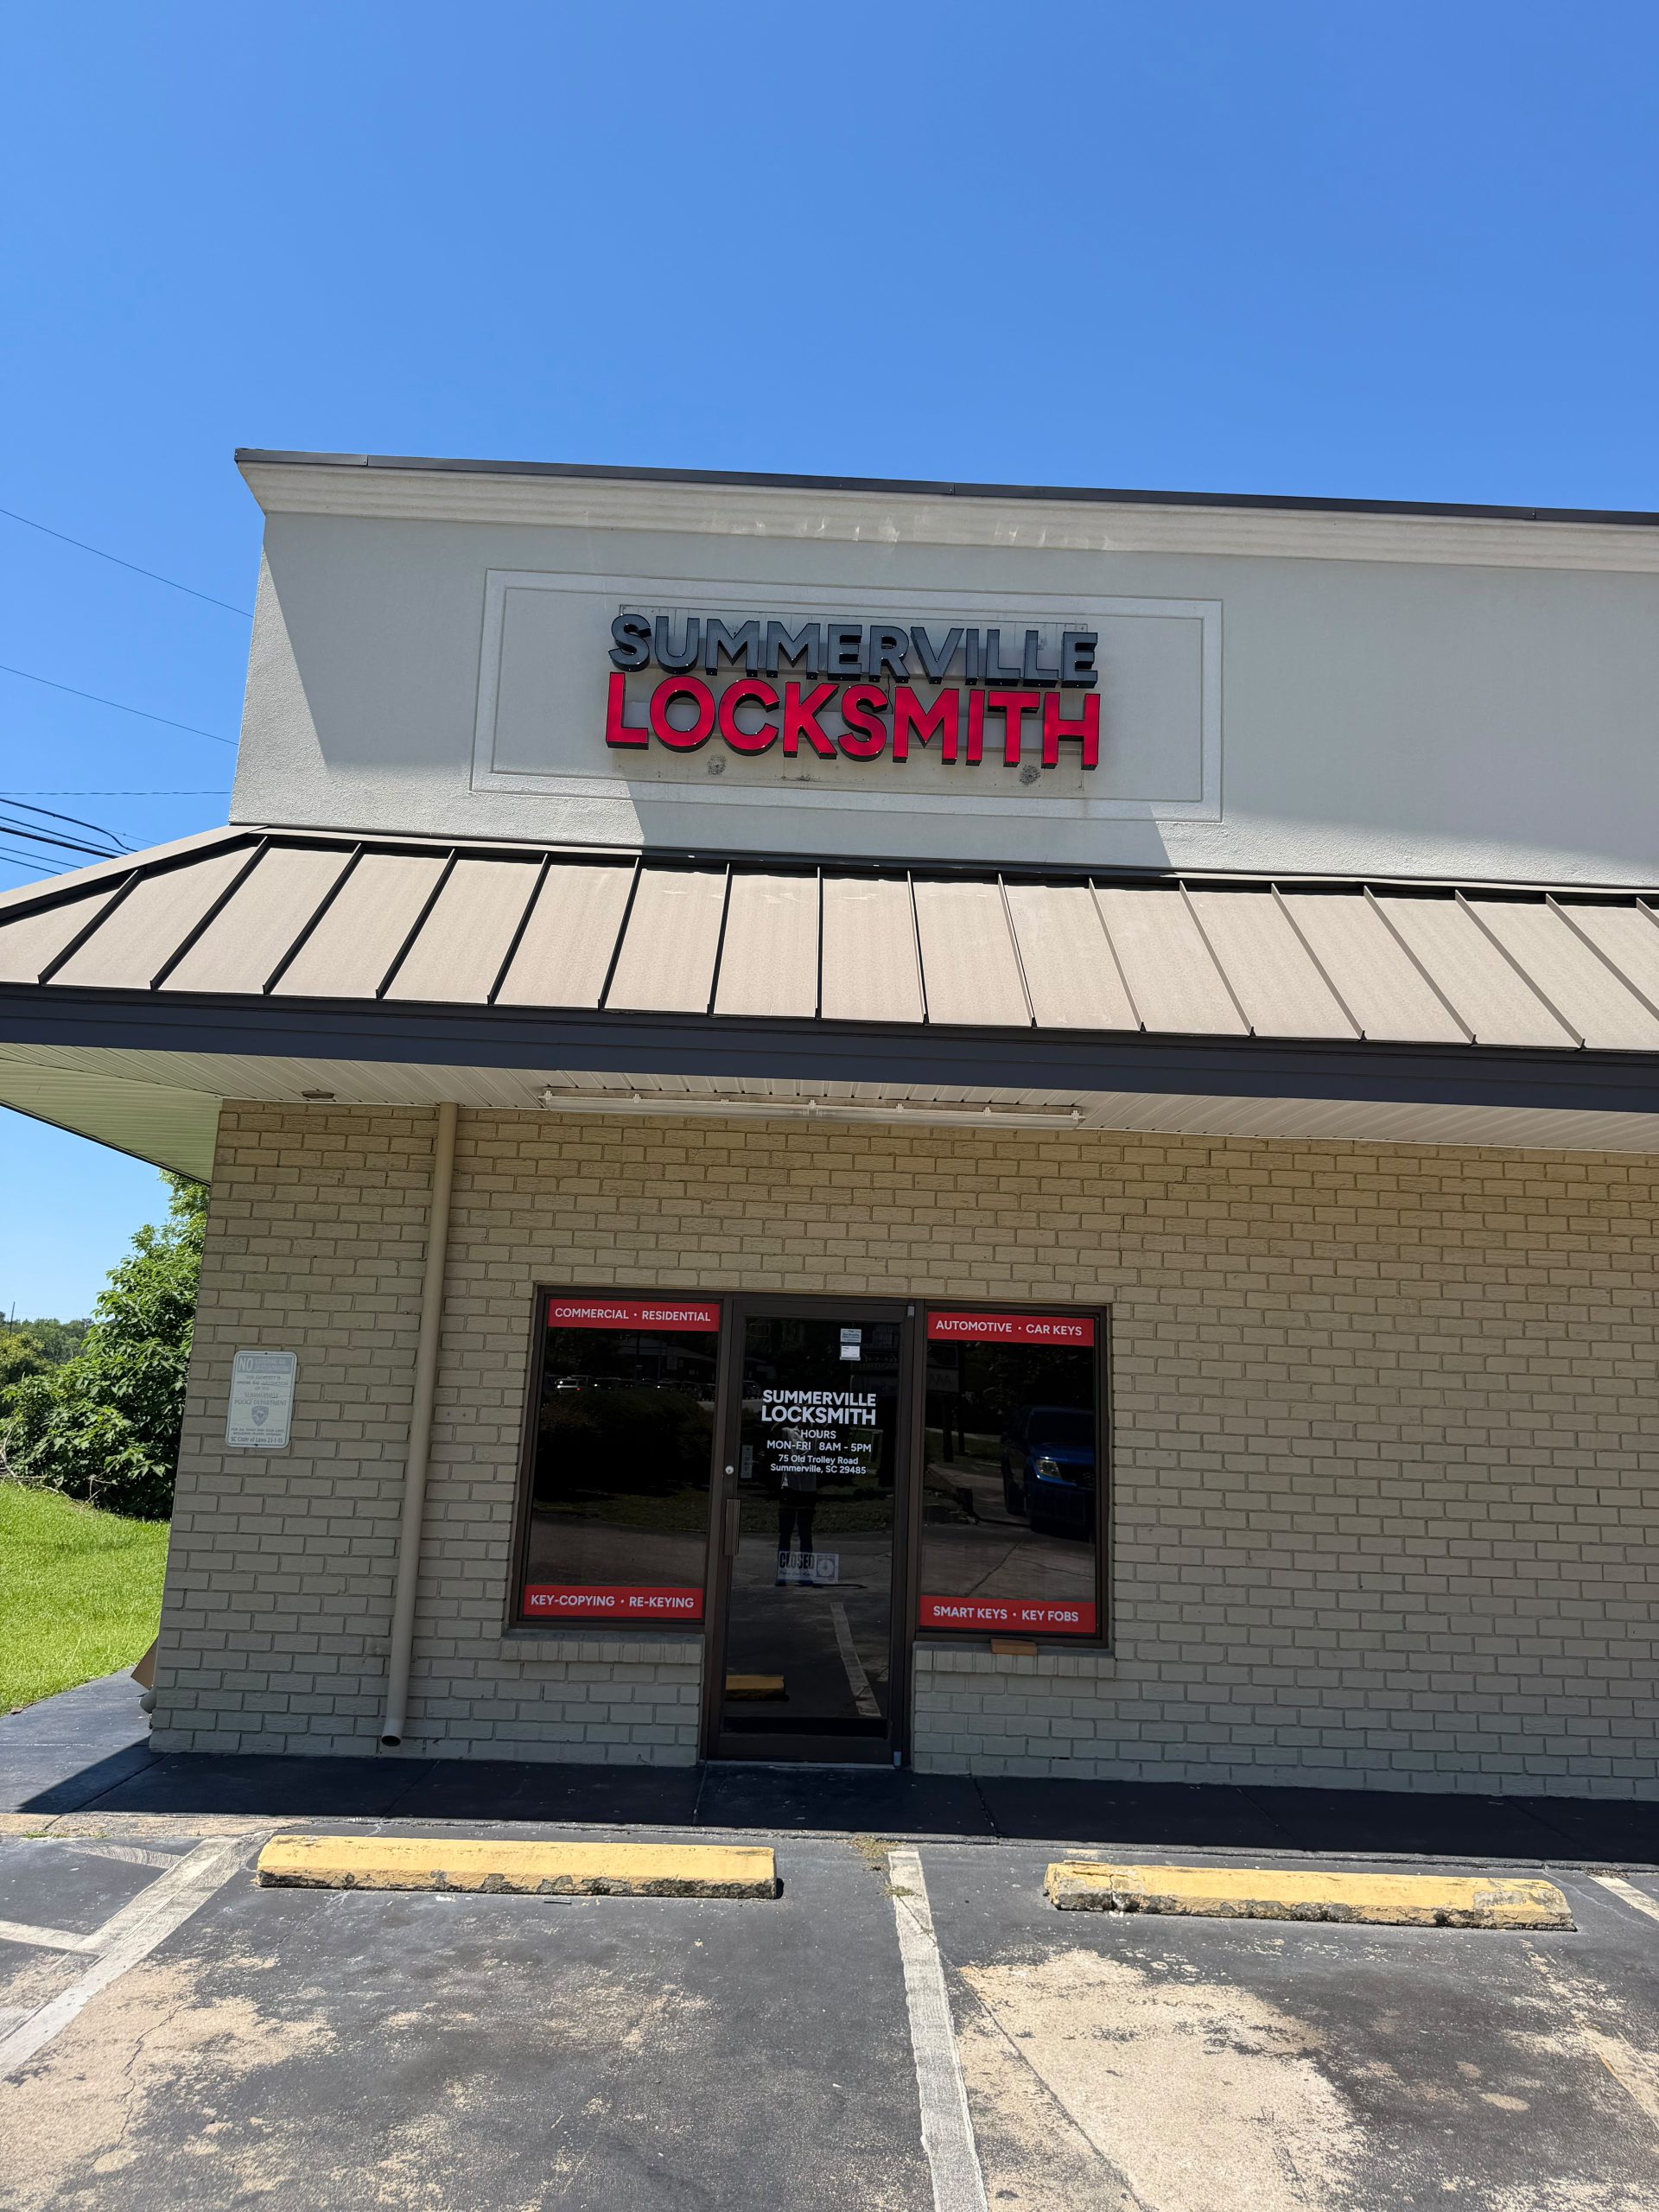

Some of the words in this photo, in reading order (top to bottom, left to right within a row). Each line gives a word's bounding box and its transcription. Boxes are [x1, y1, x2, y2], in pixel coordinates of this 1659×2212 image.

[608, 614, 1098, 688] SUMMERVILLE
[606, 672, 1100, 771] LOCKSMITH
[555, 1307, 629, 1319] COMMERCIAL
[642, 1310, 711, 1322] RESIDENTIAL
[936, 1319, 1012, 1332] AUTOMOTIVE
[1026, 1324, 1050, 1335] CAR
[1052, 1325, 1082, 1336] KEYS
[238, 1357, 253, 1371] NO
[763, 1389, 877, 1407] SUMMERVILLE
[761, 1405, 876, 1426] LOCKSMITH
[800, 1429, 836, 1440] HOURS
[766, 1440, 811, 1451] MON-FRI
[818, 1441, 842, 1452] 8AM
[850, 1443, 872, 1452] 5PM
[791, 1454, 805, 1463] Old
[807, 1455, 836, 1465] Trolley
[837, 1456, 859, 1465] Road
[770, 1463, 823, 1473] Summerville,
[839, 1465, 867, 1474] 29485
[779, 1552, 815, 1570] CLOSED
[531, 1594, 615, 1606] KEY-COPYING
[629, 1596, 695, 1608] RE-KEYING
[933, 1605, 975, 1618] SMART
[977, 1608, 1007, 1620] KEYS
[1021, 1610, 1046, 1621] KEY
[1047, 1610, 1079, 1622] FOBS
